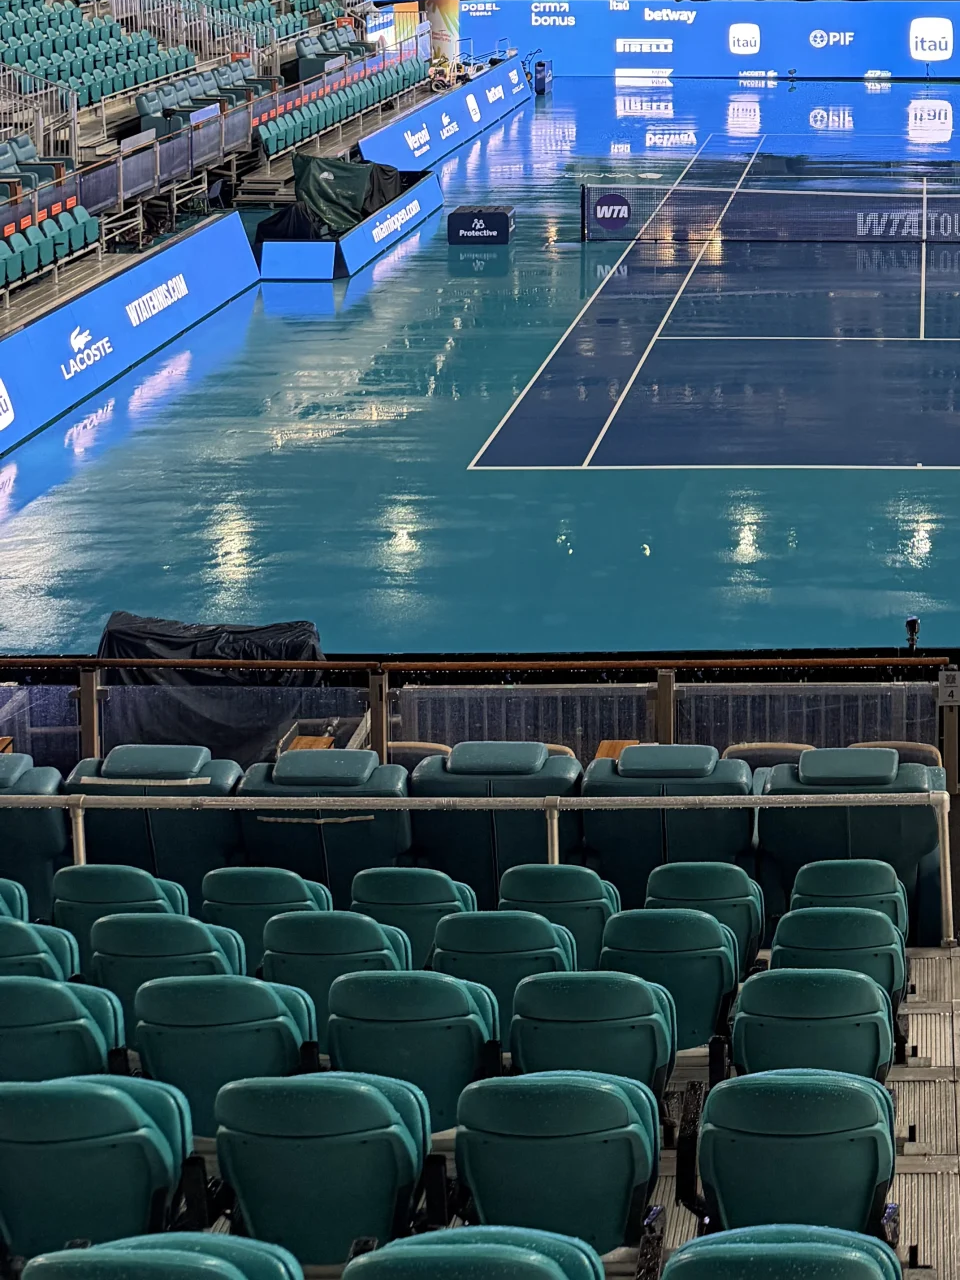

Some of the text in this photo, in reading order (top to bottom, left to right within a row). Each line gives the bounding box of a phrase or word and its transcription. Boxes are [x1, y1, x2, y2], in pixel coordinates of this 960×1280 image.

[531, 13, 576, 26] bonus
[644, 7, 697, 24] betway
[616, 38, 673, 53] PIRELLI
[732, 36, 757, 48] itaú
[829, 32, 854, 45] PIF
[914, 35, 948, 51] itaú
[403, 122, 431, 151] Veroni
[595, 205, 629, 220] WTA
[372, 199, 421, 243] miamiopen.com
[857, 212, 919, 236] WTA
[459, 229, 498, 238] Protective
[125, 273, 189, 328] WTATENNIS.COM
[61, 336, 114, 381] LACOSTE
[947, 689, 955, 700] 4
